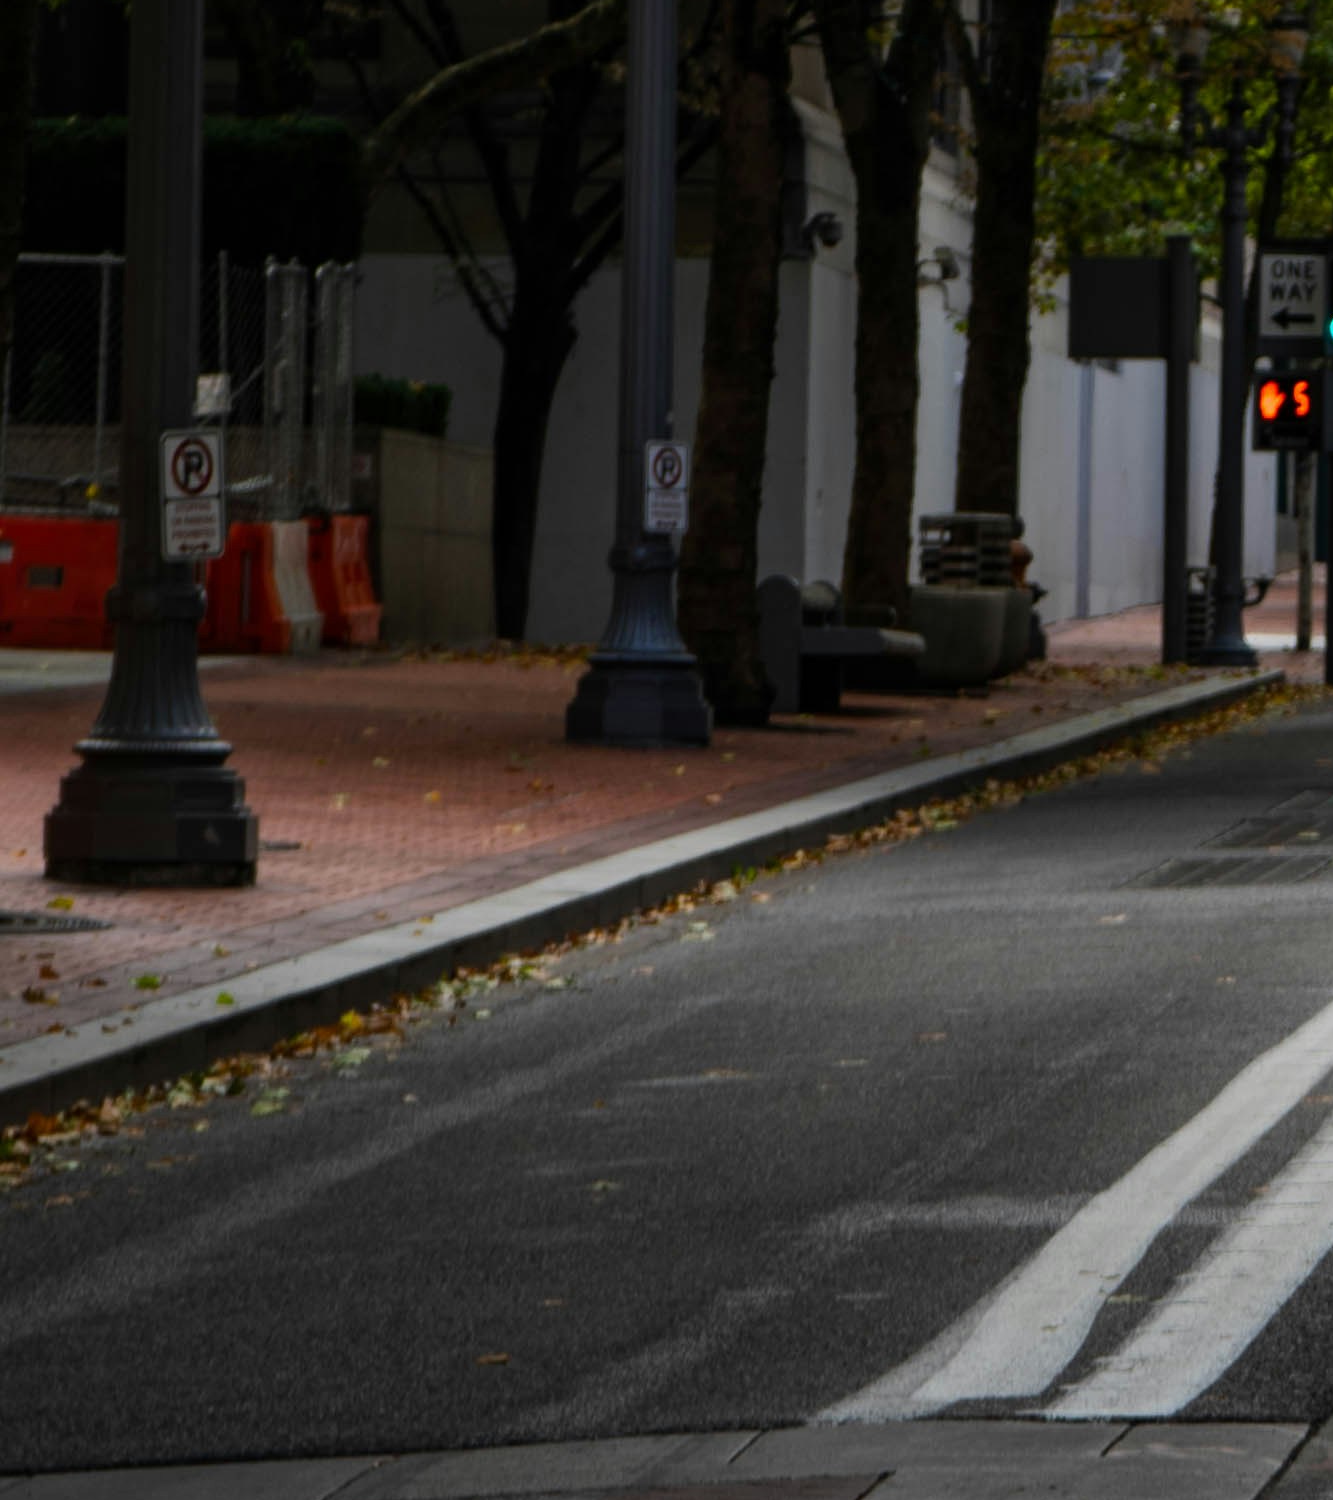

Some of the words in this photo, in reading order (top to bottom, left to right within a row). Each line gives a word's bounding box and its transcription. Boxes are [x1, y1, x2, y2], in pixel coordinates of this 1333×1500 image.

[1271, 259, 1314, 278] ONE
[1269, 283, 1317, 301] WAY
[1293, 380, 1310, 418] 5
